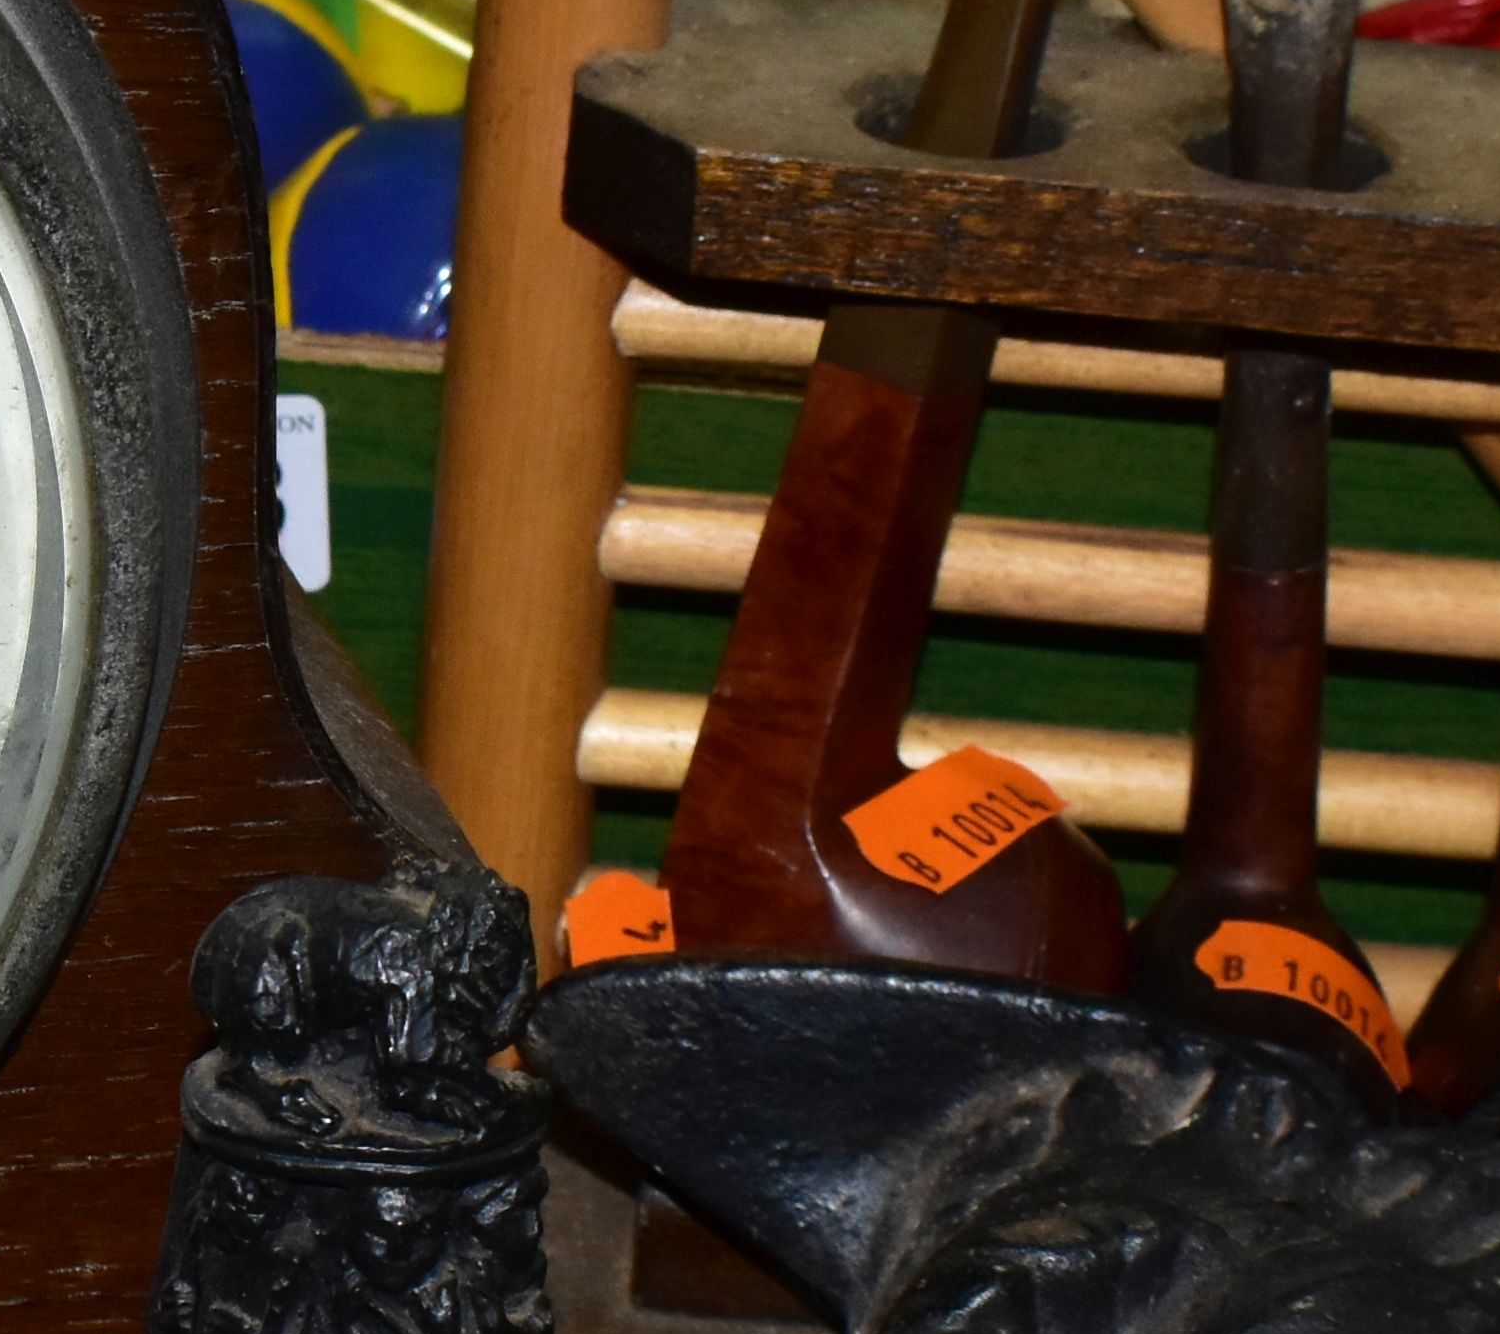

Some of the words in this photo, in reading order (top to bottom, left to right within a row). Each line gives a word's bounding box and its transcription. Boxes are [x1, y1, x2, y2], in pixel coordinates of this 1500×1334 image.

[897, 851, 942, 883] B
[931, 783, 1051, 859] 10014
[1222, 955, 1244, 982] B
